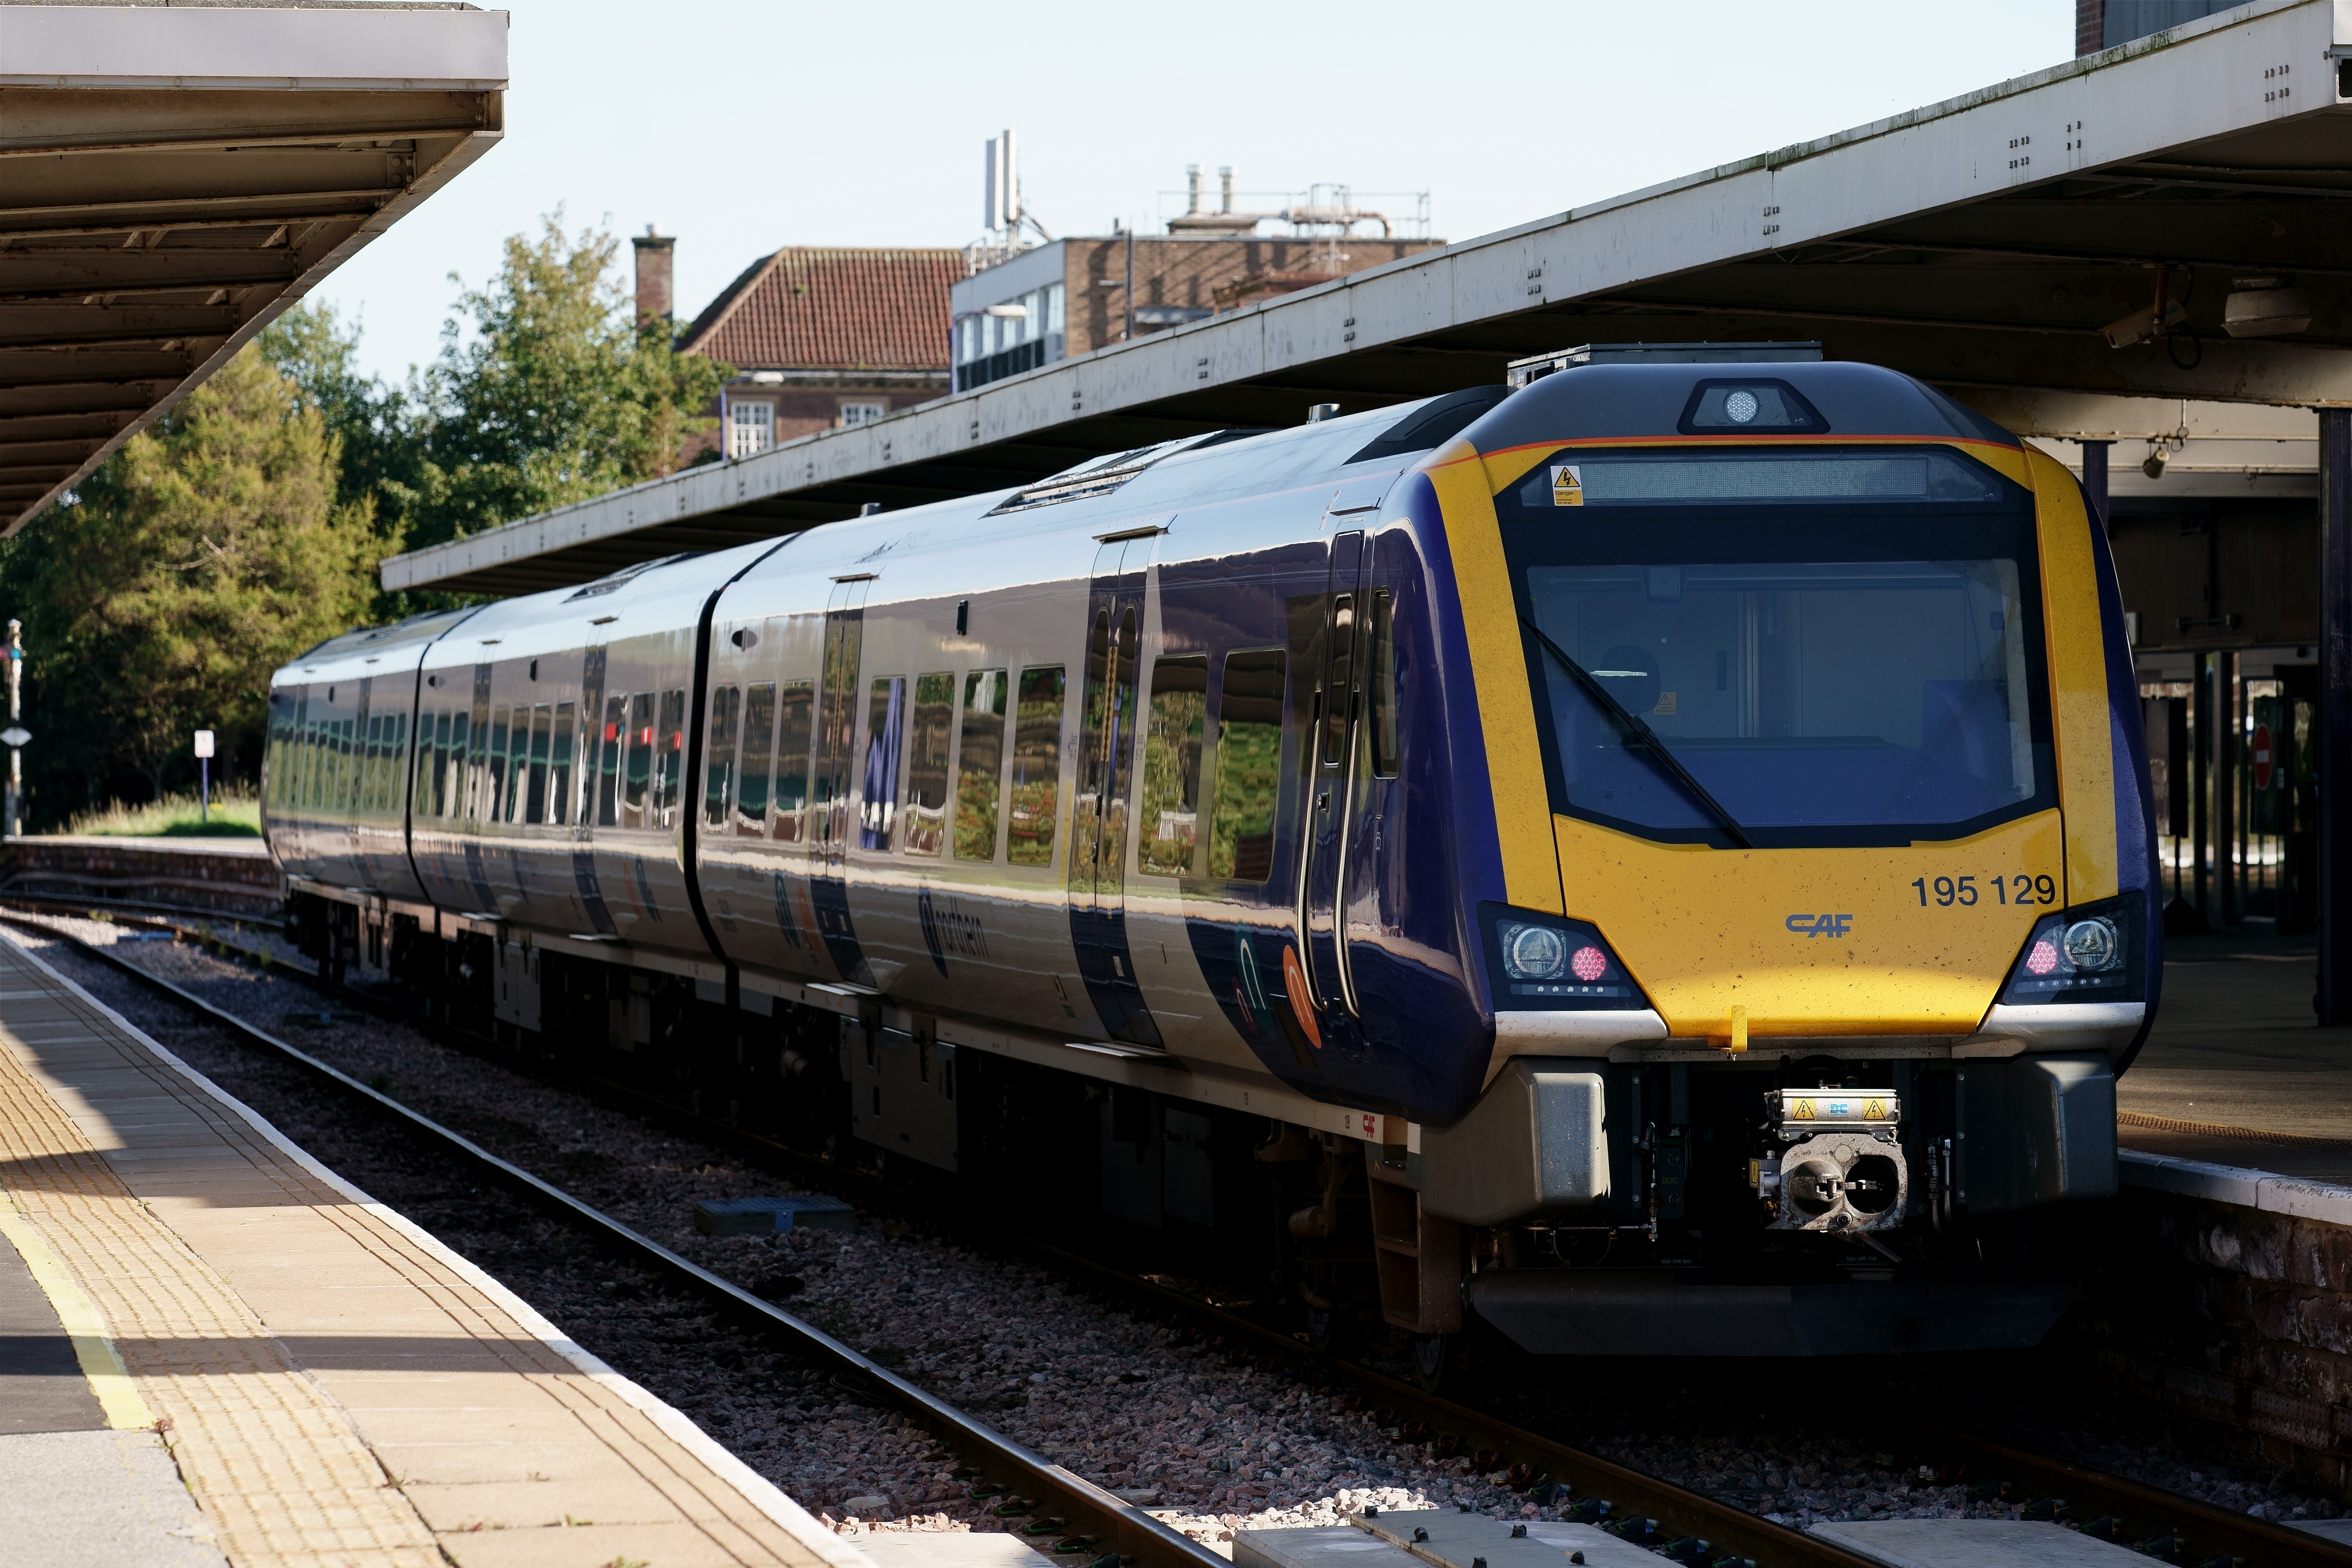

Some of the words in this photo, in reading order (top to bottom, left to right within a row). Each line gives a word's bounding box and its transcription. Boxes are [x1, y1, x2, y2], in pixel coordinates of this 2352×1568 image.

[2148, 305, 2179, 323] SENS
[1911, 875, 1979, 907] 195
[1990, 874, 2056, 905] 129
[935, 896, 990, 959] northern
[1785, 914, 1853, 938] CAF
[1363, 1114, 1375, 1138] CAF
